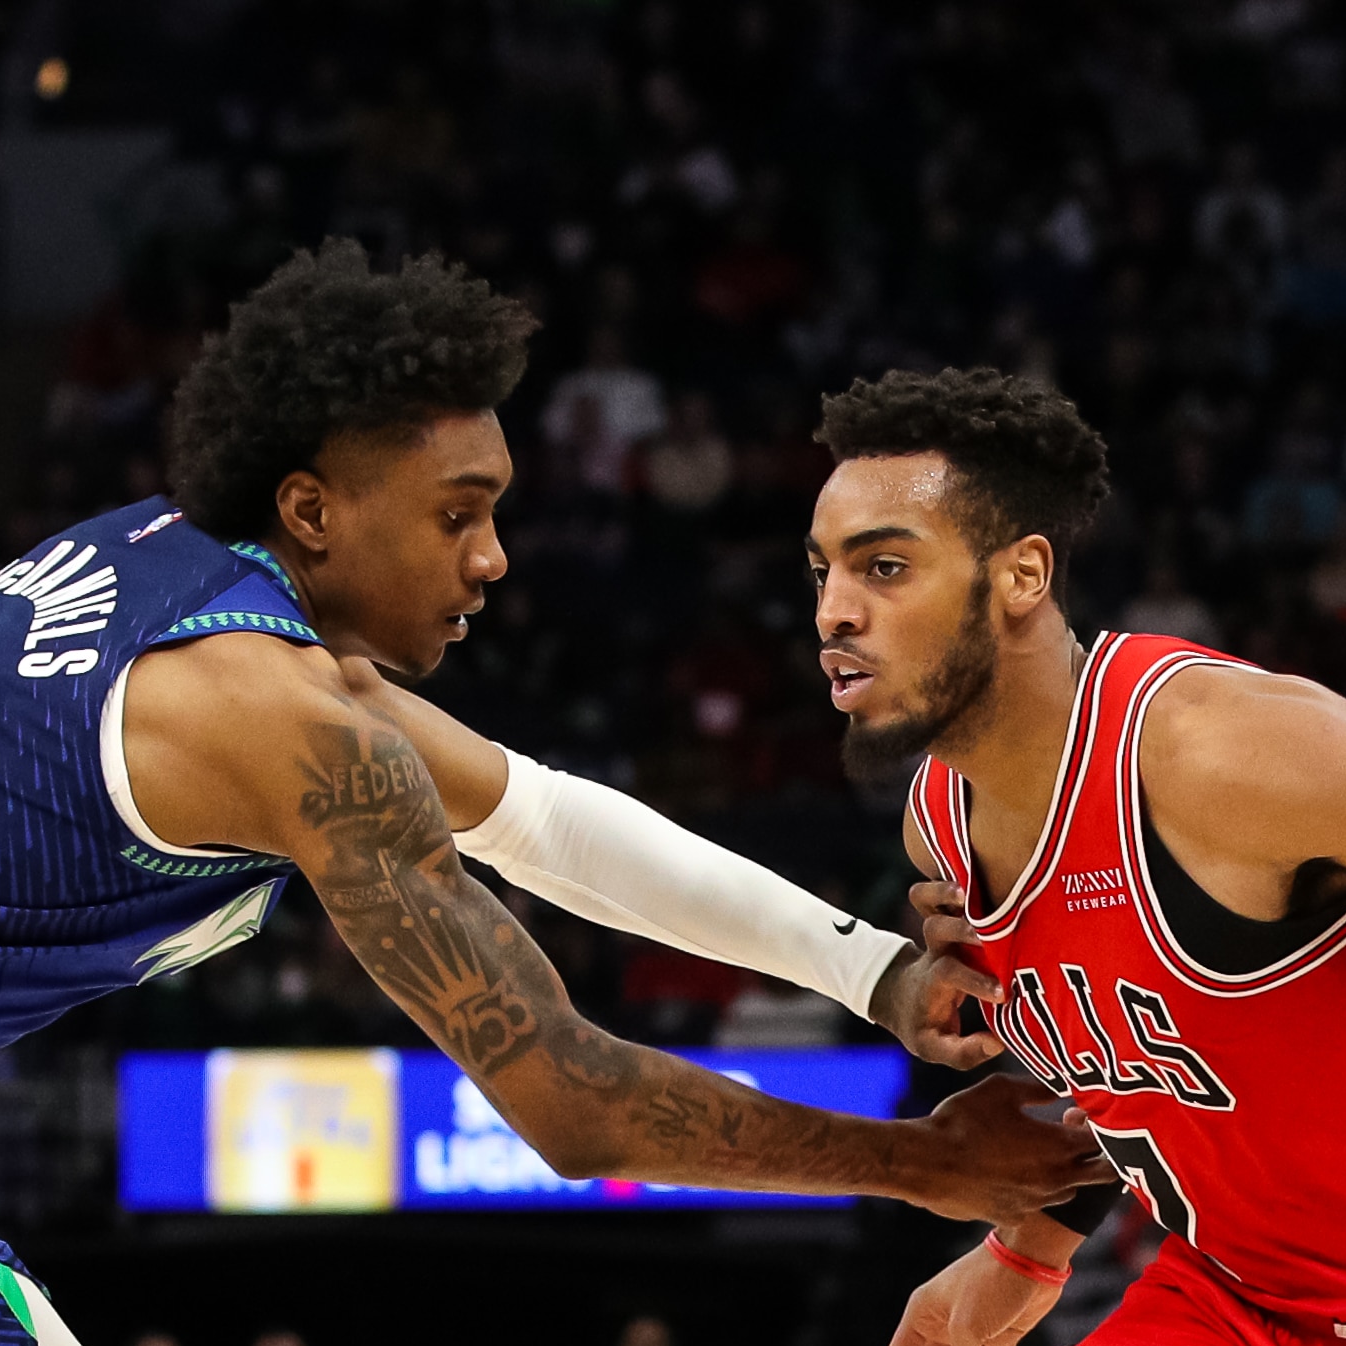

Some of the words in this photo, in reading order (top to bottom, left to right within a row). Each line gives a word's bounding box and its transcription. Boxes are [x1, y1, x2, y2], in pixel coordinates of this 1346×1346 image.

[1061, 867, 1124, 895] ZENNI
[1066, 893, 1127, 912] EYEWEAR
[988, 962, 1237, 1112] ULLS
[1086, 1118, 1199, 1250] 7
